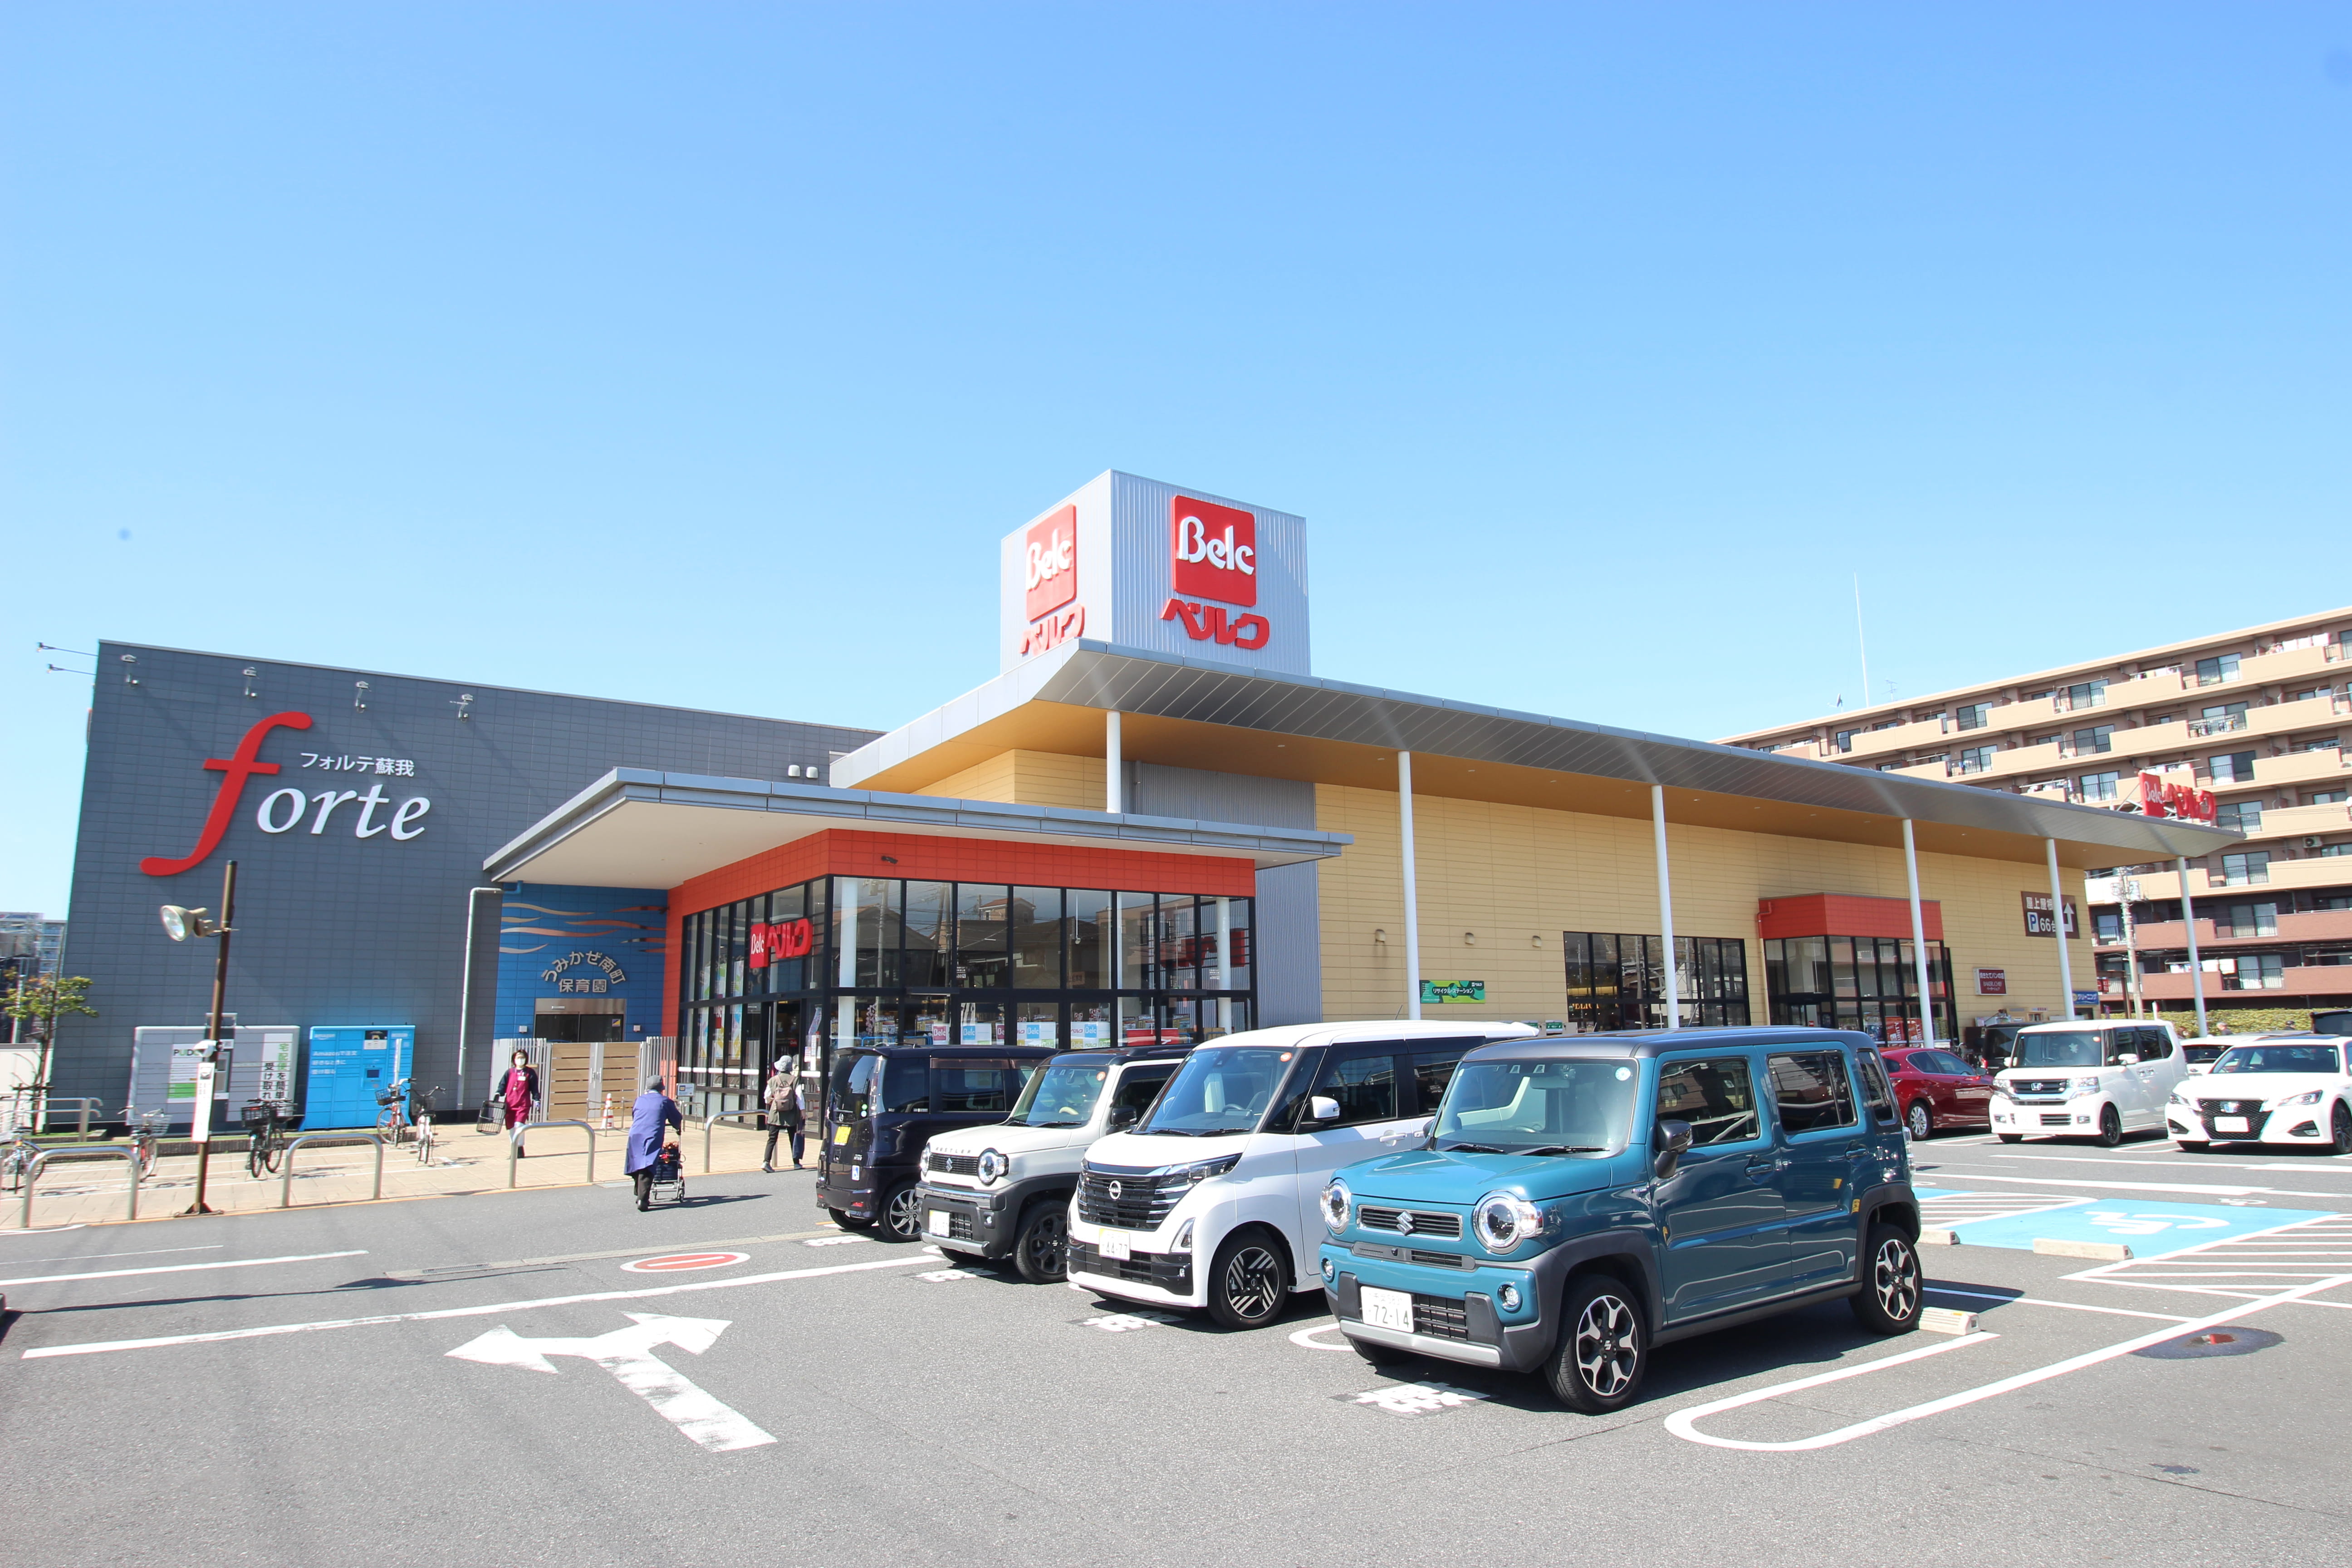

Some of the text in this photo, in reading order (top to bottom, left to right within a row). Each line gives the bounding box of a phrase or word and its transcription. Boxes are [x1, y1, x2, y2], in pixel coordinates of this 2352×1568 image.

[1025, 528, 1071, 590] Belc
[1176, 516, 1254, 575] Belc
[1019, 603, 1085, 656] ベルク
[1160, 598, 1269, 650] ベルク
[300, 752, 415, 777] フォルテ蘇我
[140, 711, 430, 876] forte
[2144, 781, 2164, 804] Belc
[2163, 783, 2216, 821] ベルク
[751, 932, 764, 955] Belc
[766, 918, 813, 960] ベルク
[541, 951, 626, 985] うみかぜ南町
[558, 978, 607, 993] 保育園
[933, 1028, 946, 1037] Belc
[963, 1028, 976, 1037] Belc
